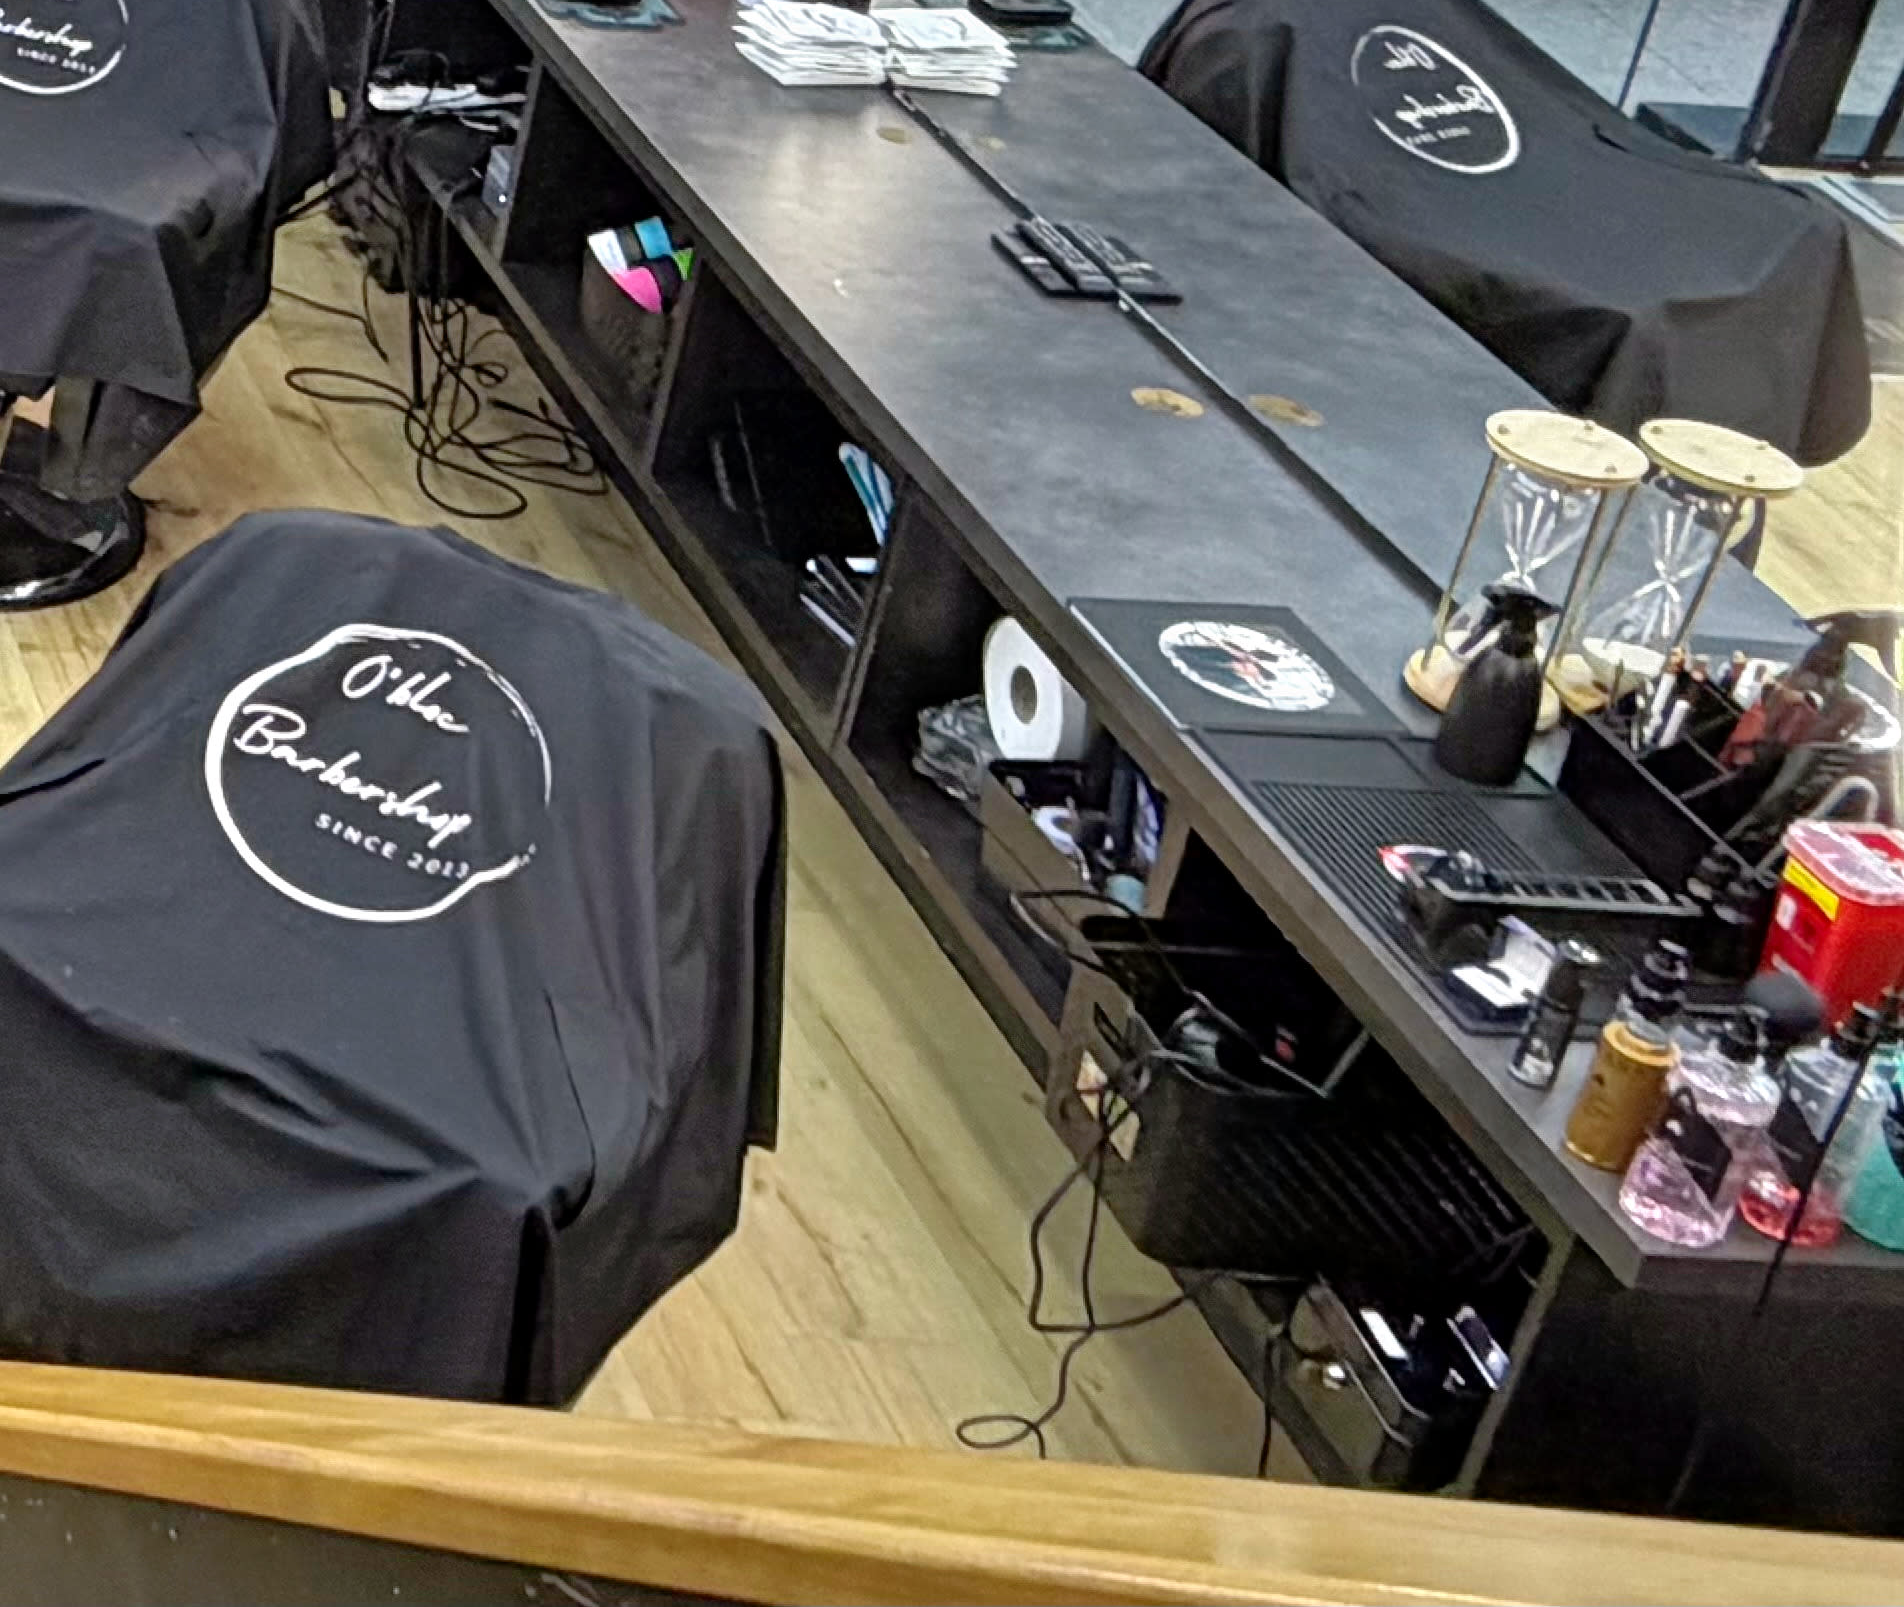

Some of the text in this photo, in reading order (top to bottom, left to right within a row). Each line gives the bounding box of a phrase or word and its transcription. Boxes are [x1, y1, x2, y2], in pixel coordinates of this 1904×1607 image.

[232, 703, 473, 850] Barbershop
[314, 812, 470, 880] SINCE 2013
